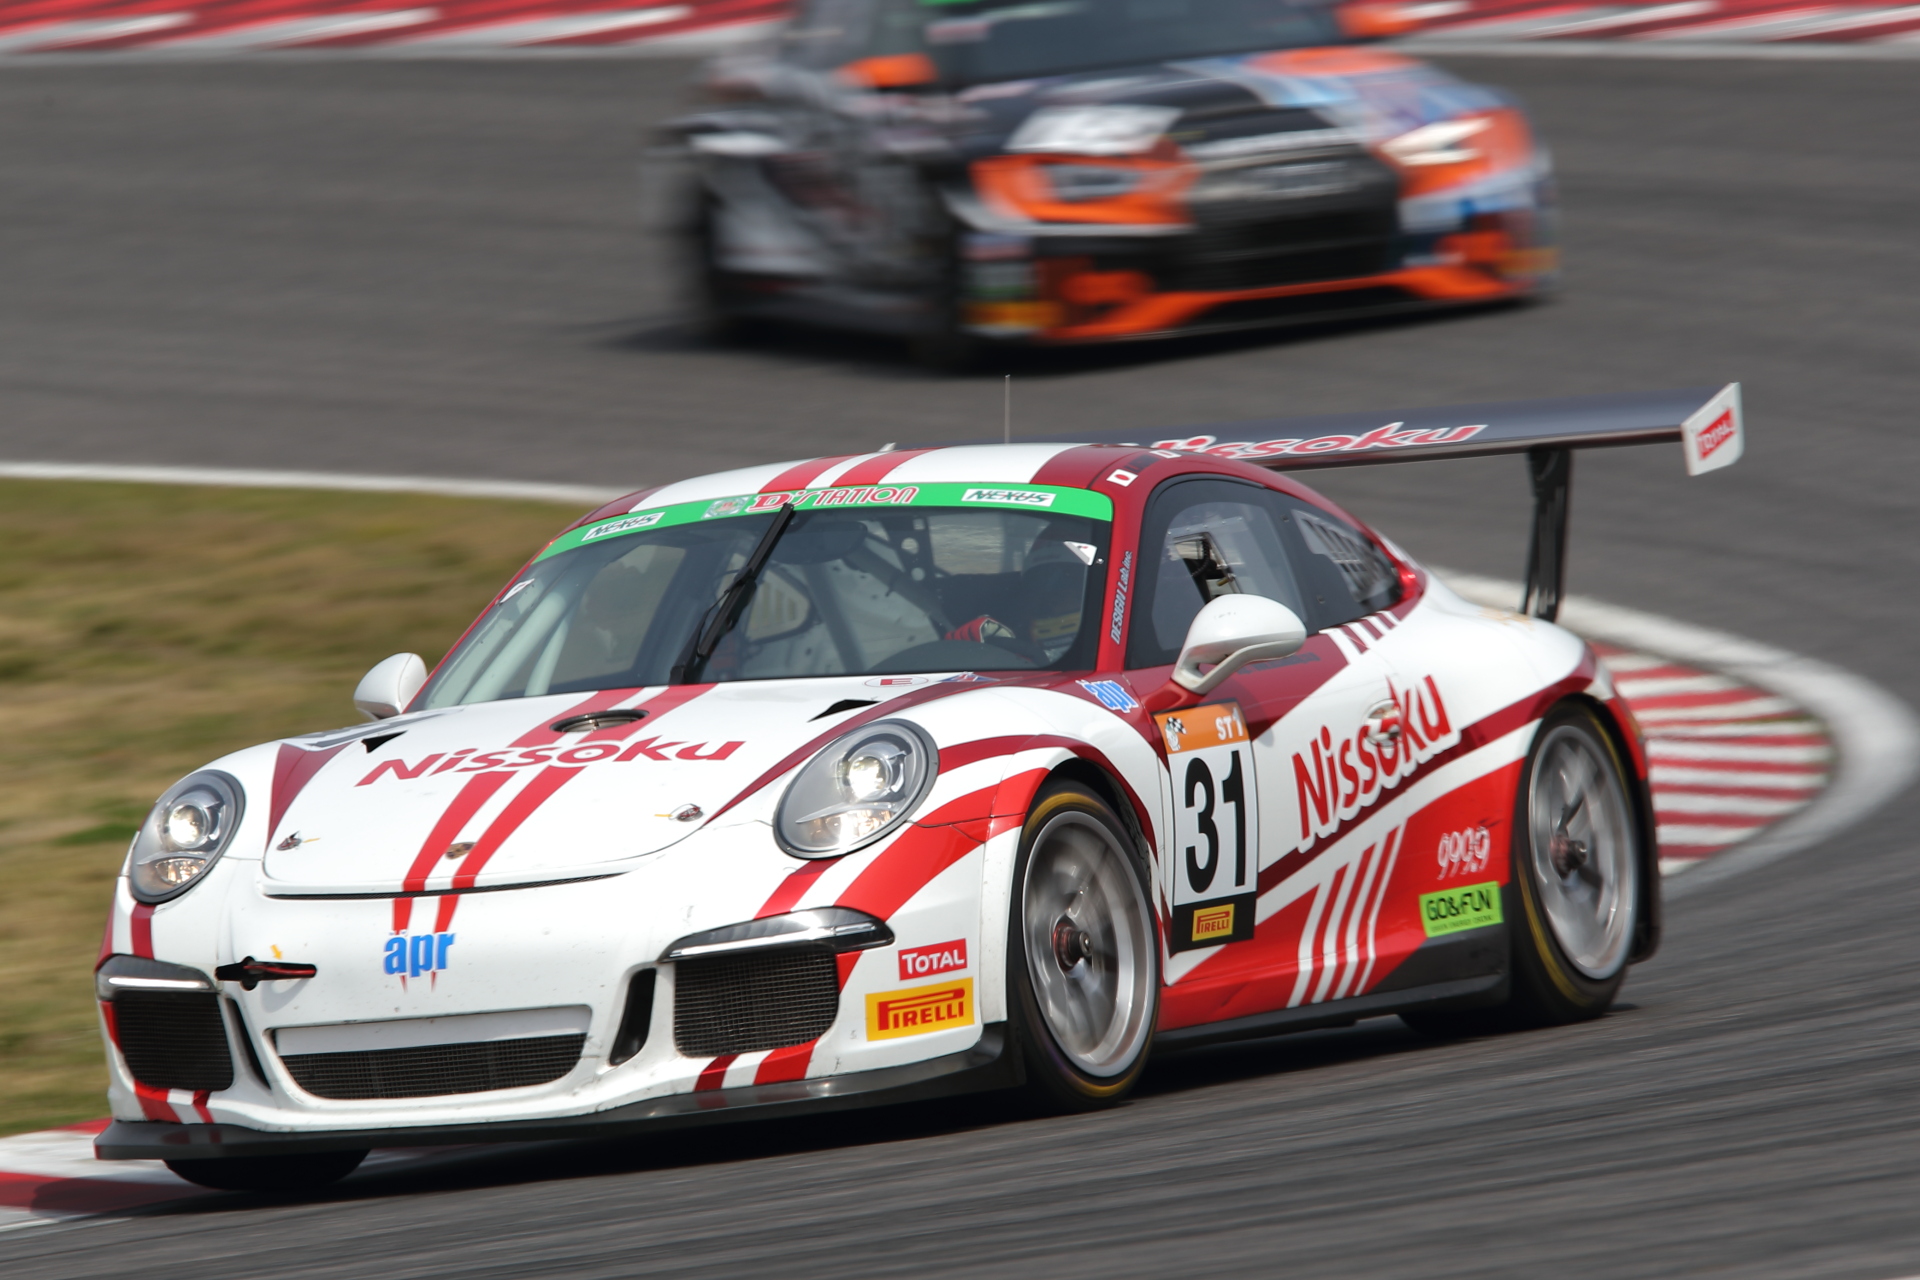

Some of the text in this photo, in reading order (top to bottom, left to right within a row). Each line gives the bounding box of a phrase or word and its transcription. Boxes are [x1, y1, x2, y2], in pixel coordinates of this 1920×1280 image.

[965, 489, 1051, 503] NEXUS
[1110, 588, 1126, 645] DESIGN
[354, 735, 746, 787] Nissoku
[1292, 674, 1452, 841] Nissoku
[1185, 750, 1246, 894] 31
[1196, 910, 1230, 935] PIRELLI
[1426, 889, 1492, 921] GO&FUN
[384, 932, 456, 978] apr
[902, 949, 965, 975] TOTAL
[877, 987, 966, 1032] PIRELLI
